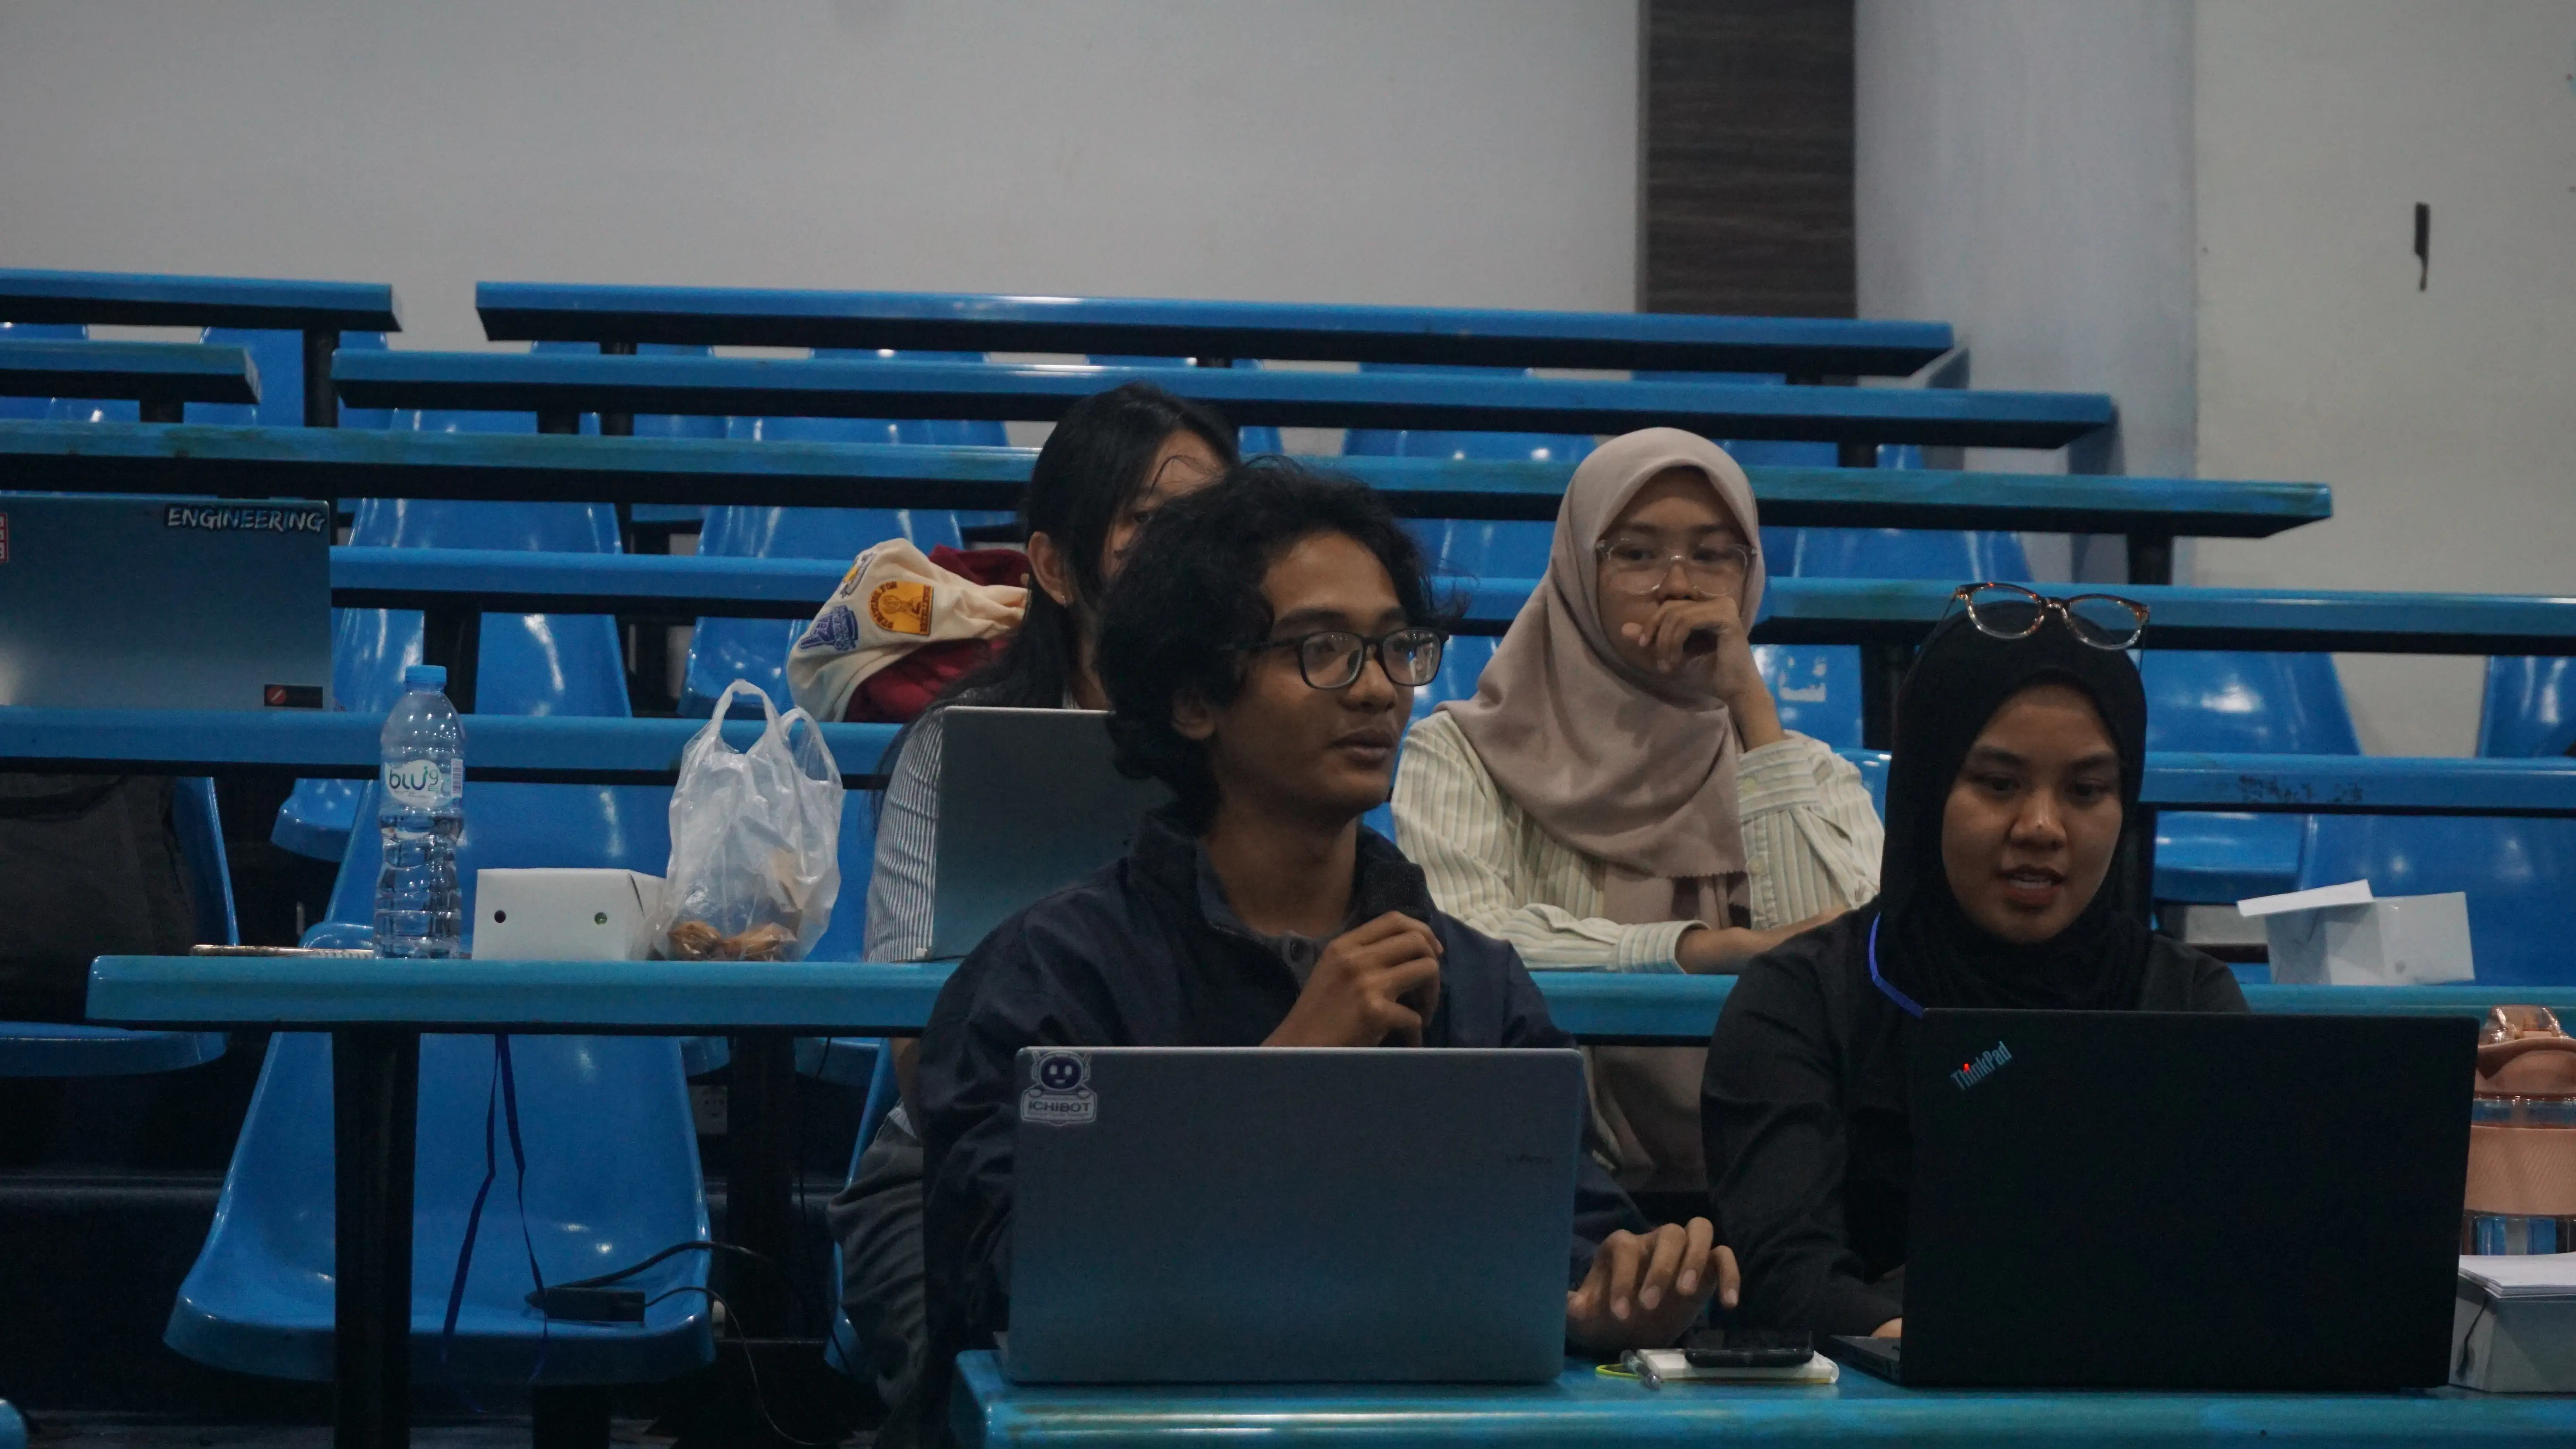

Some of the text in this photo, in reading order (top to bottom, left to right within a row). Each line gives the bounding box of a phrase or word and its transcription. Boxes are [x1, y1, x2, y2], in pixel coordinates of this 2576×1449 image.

[168, 507, 325, 532] ENGINEERING
[1950, 1040, 2012, 1090] ThinkPad
[1029, 1100, 1091, 1112] ICHIBOT
